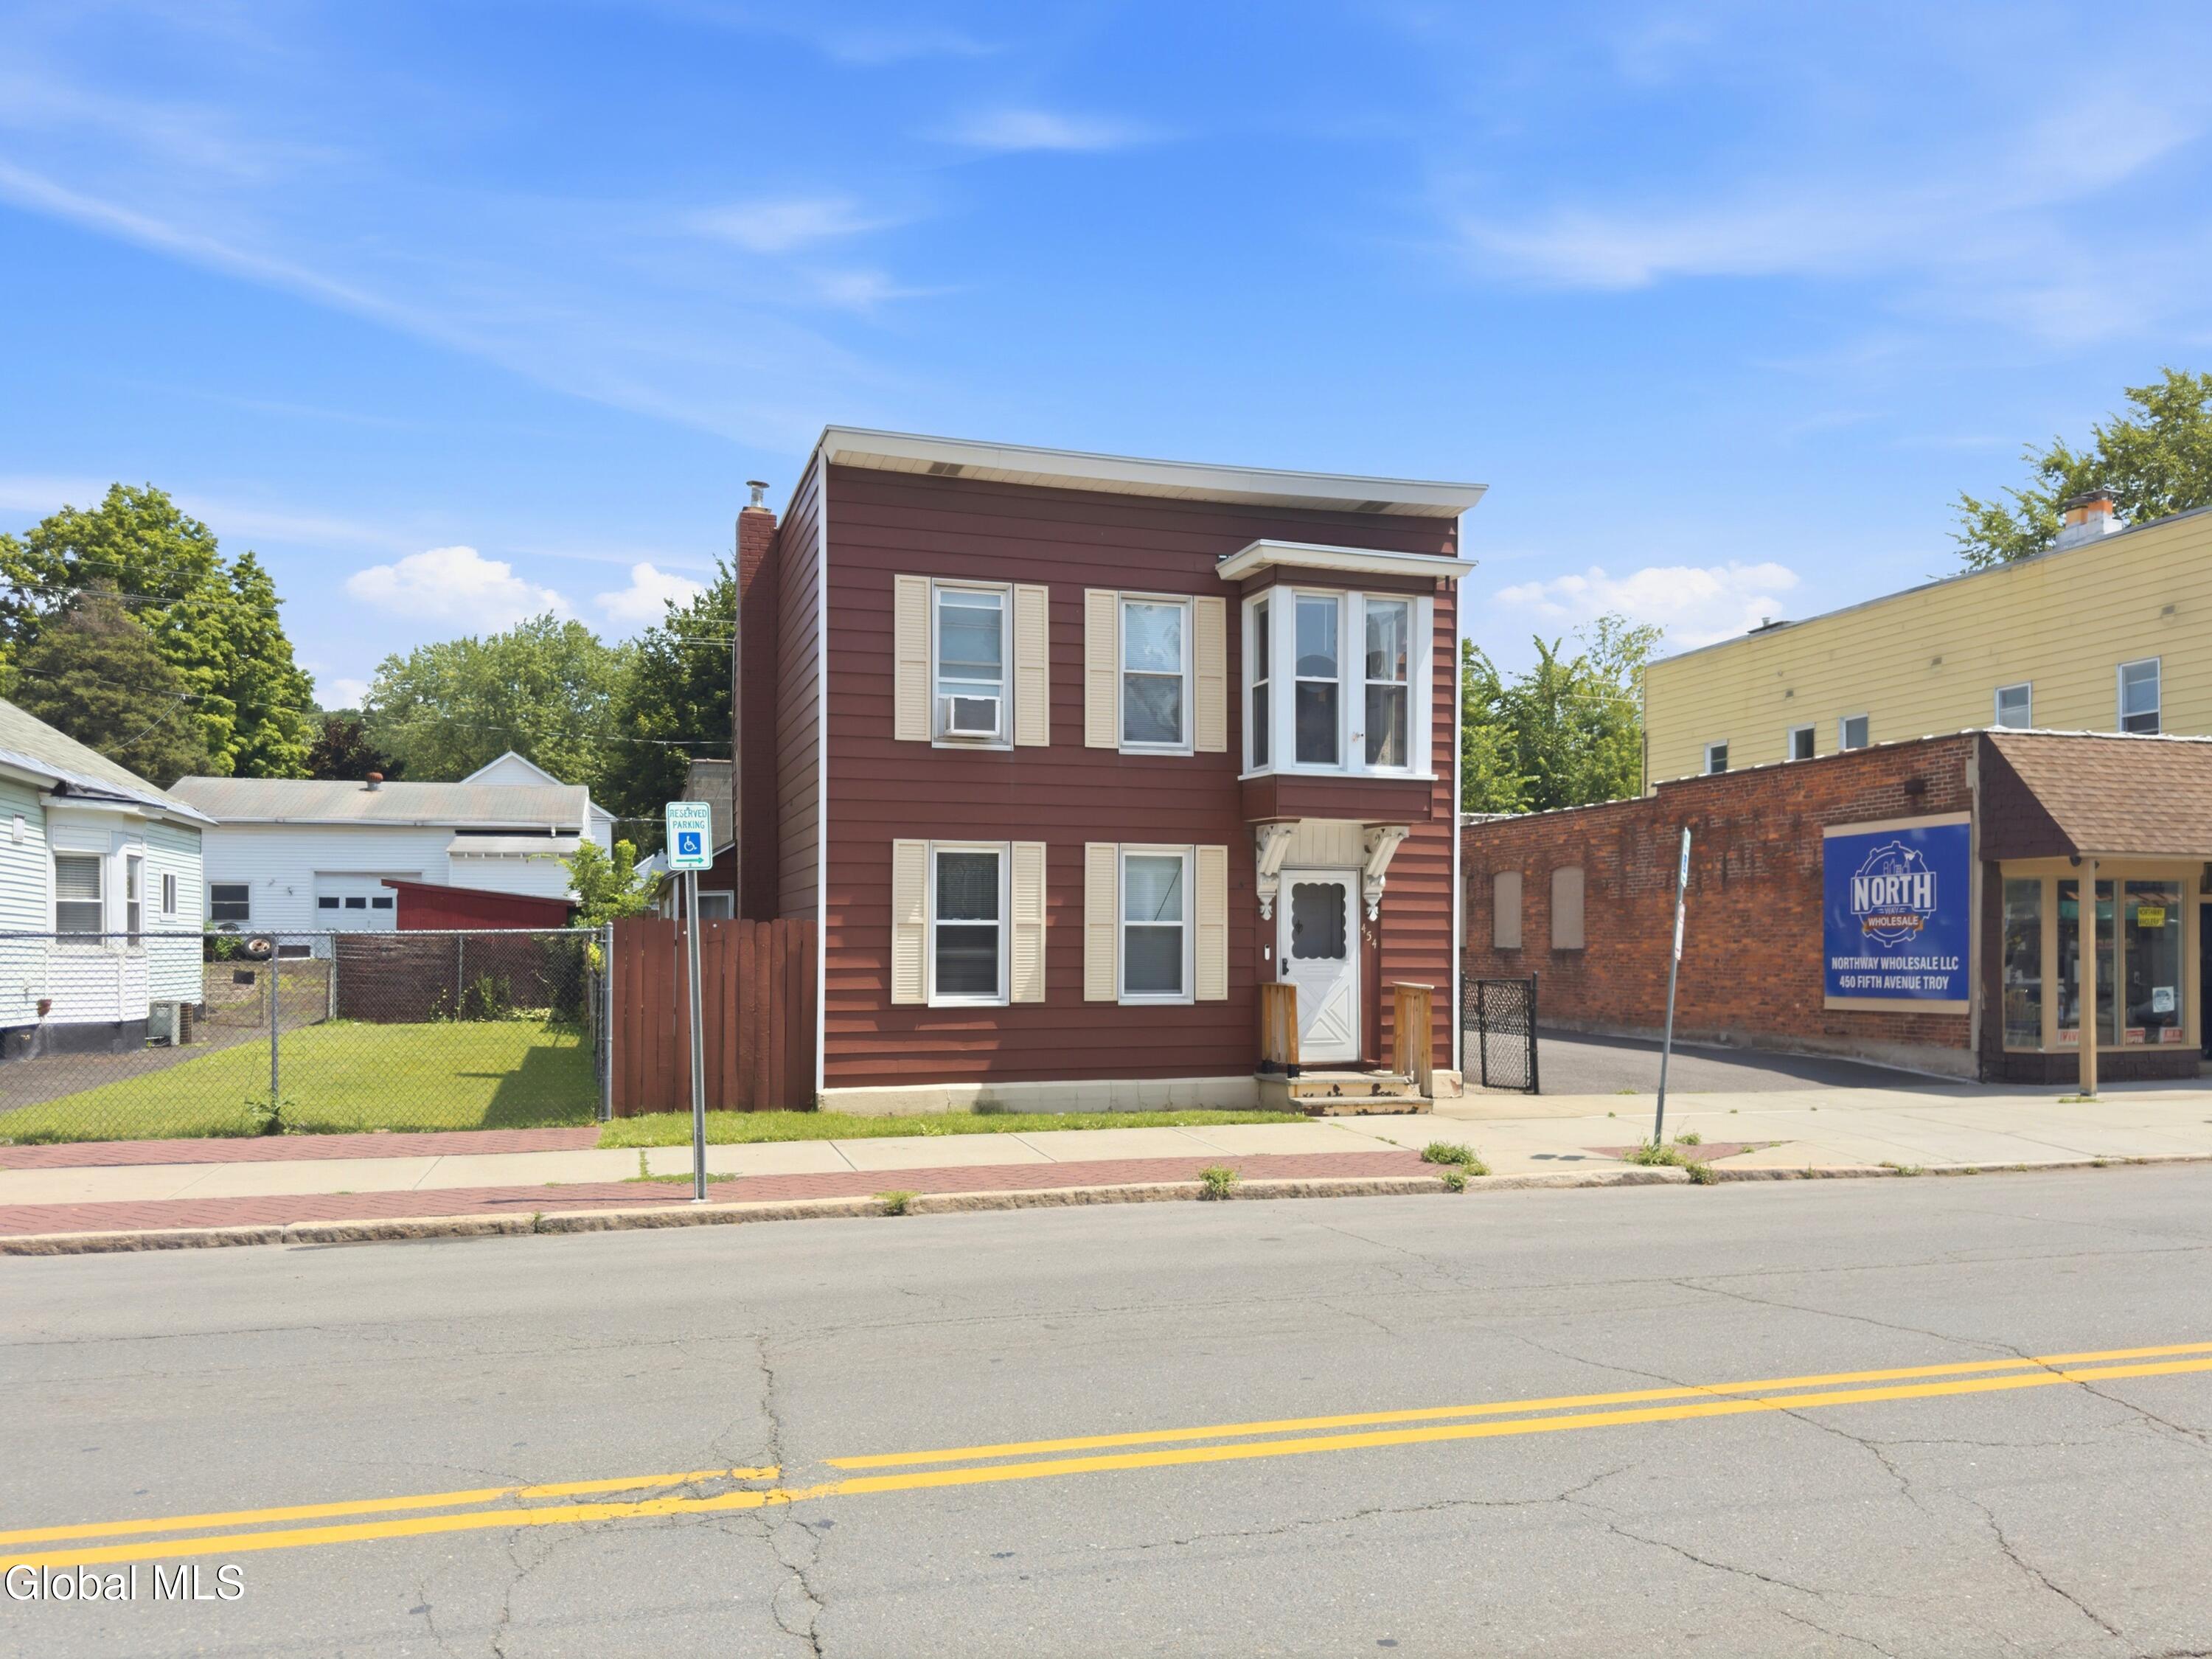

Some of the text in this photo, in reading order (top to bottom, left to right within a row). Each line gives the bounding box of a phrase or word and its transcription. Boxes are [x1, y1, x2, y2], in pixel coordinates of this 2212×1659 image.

[669, 809, 707, 818] RESERVED
[672, 821, 705, 829] PARKING
[1854, 874, 1931, 911] NORTH
[1885, 906, 1899, 914] WAY
[1868, 915, 1919, 927] WHOLESALE
[1361, 923, 1377, 949] 454
[1832, 956, 1959, 970] NORTHWAY WHOLESALE LLC
[1840, 975, 1949, 990] 450 FIFTH AVENUE TROY
